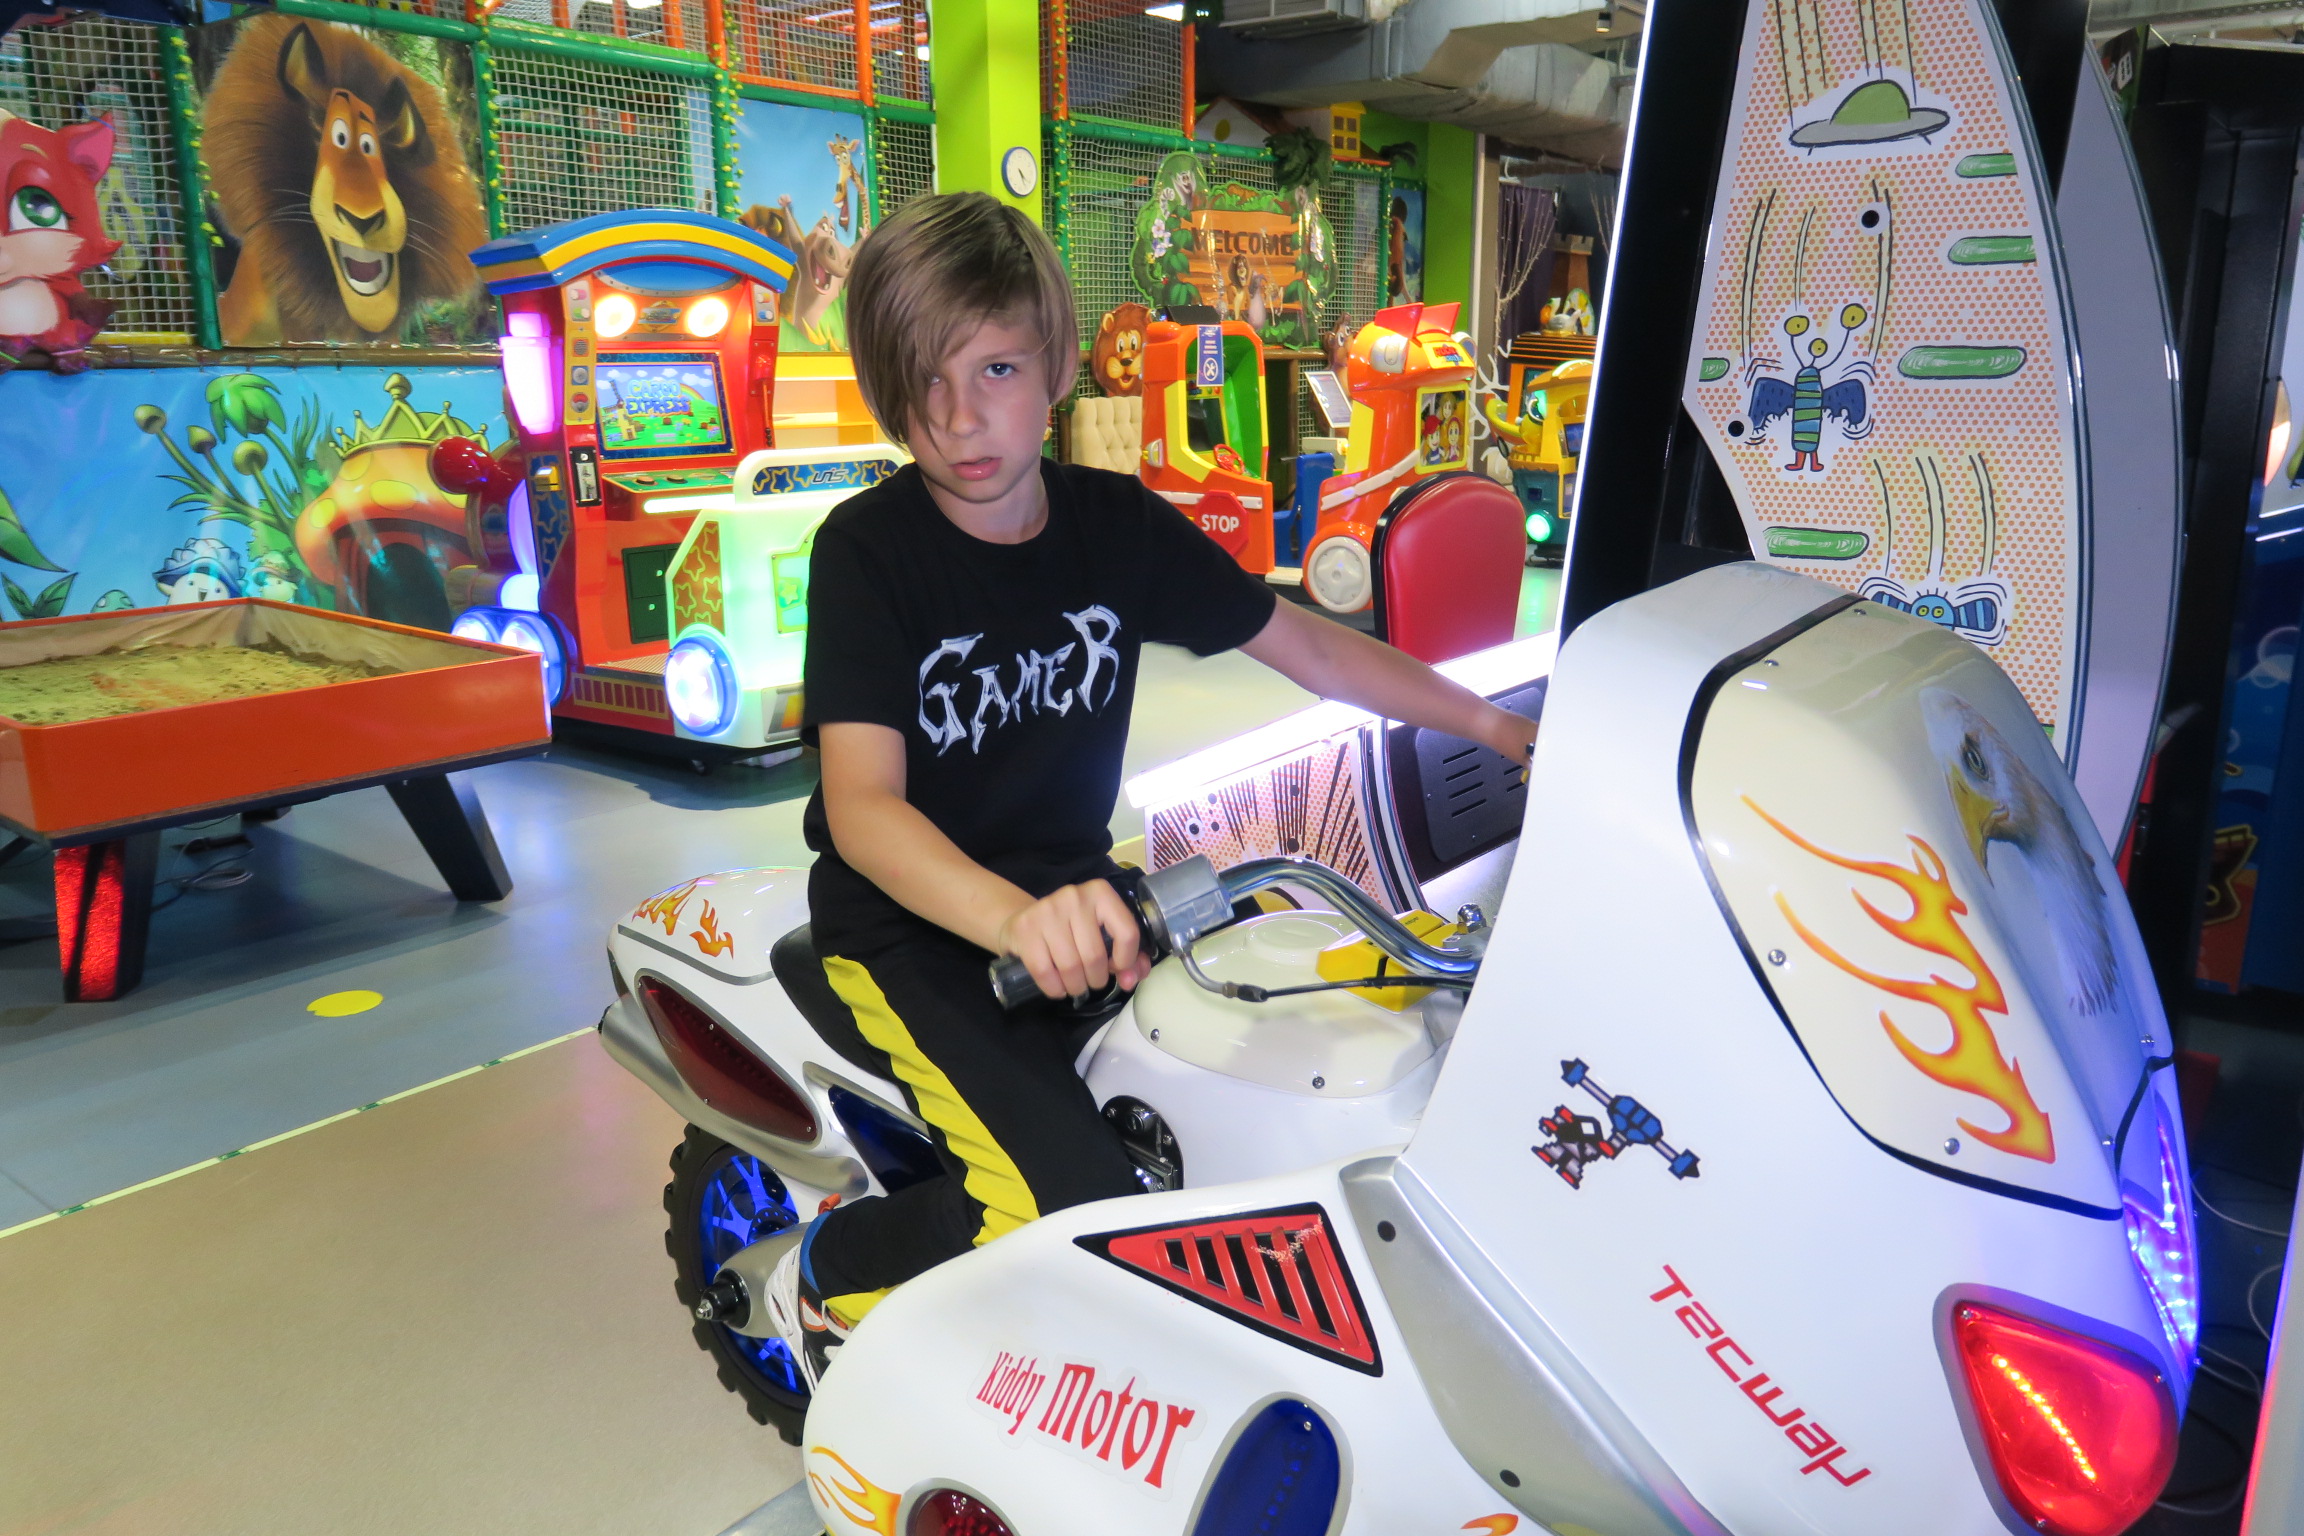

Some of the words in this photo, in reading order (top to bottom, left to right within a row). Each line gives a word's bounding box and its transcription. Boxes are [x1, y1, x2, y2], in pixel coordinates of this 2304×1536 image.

[1191, 227, 1294, 256] WELCOME
[624, 396, 692, 415] EXPRESS
[1201, 514, 1240, 533] STOP
[918, 603, 1122, 757] GAMER
[975, 1351, 1046, 1436] Kiddy
[1037, 1363, 1196, 1489] Motor
